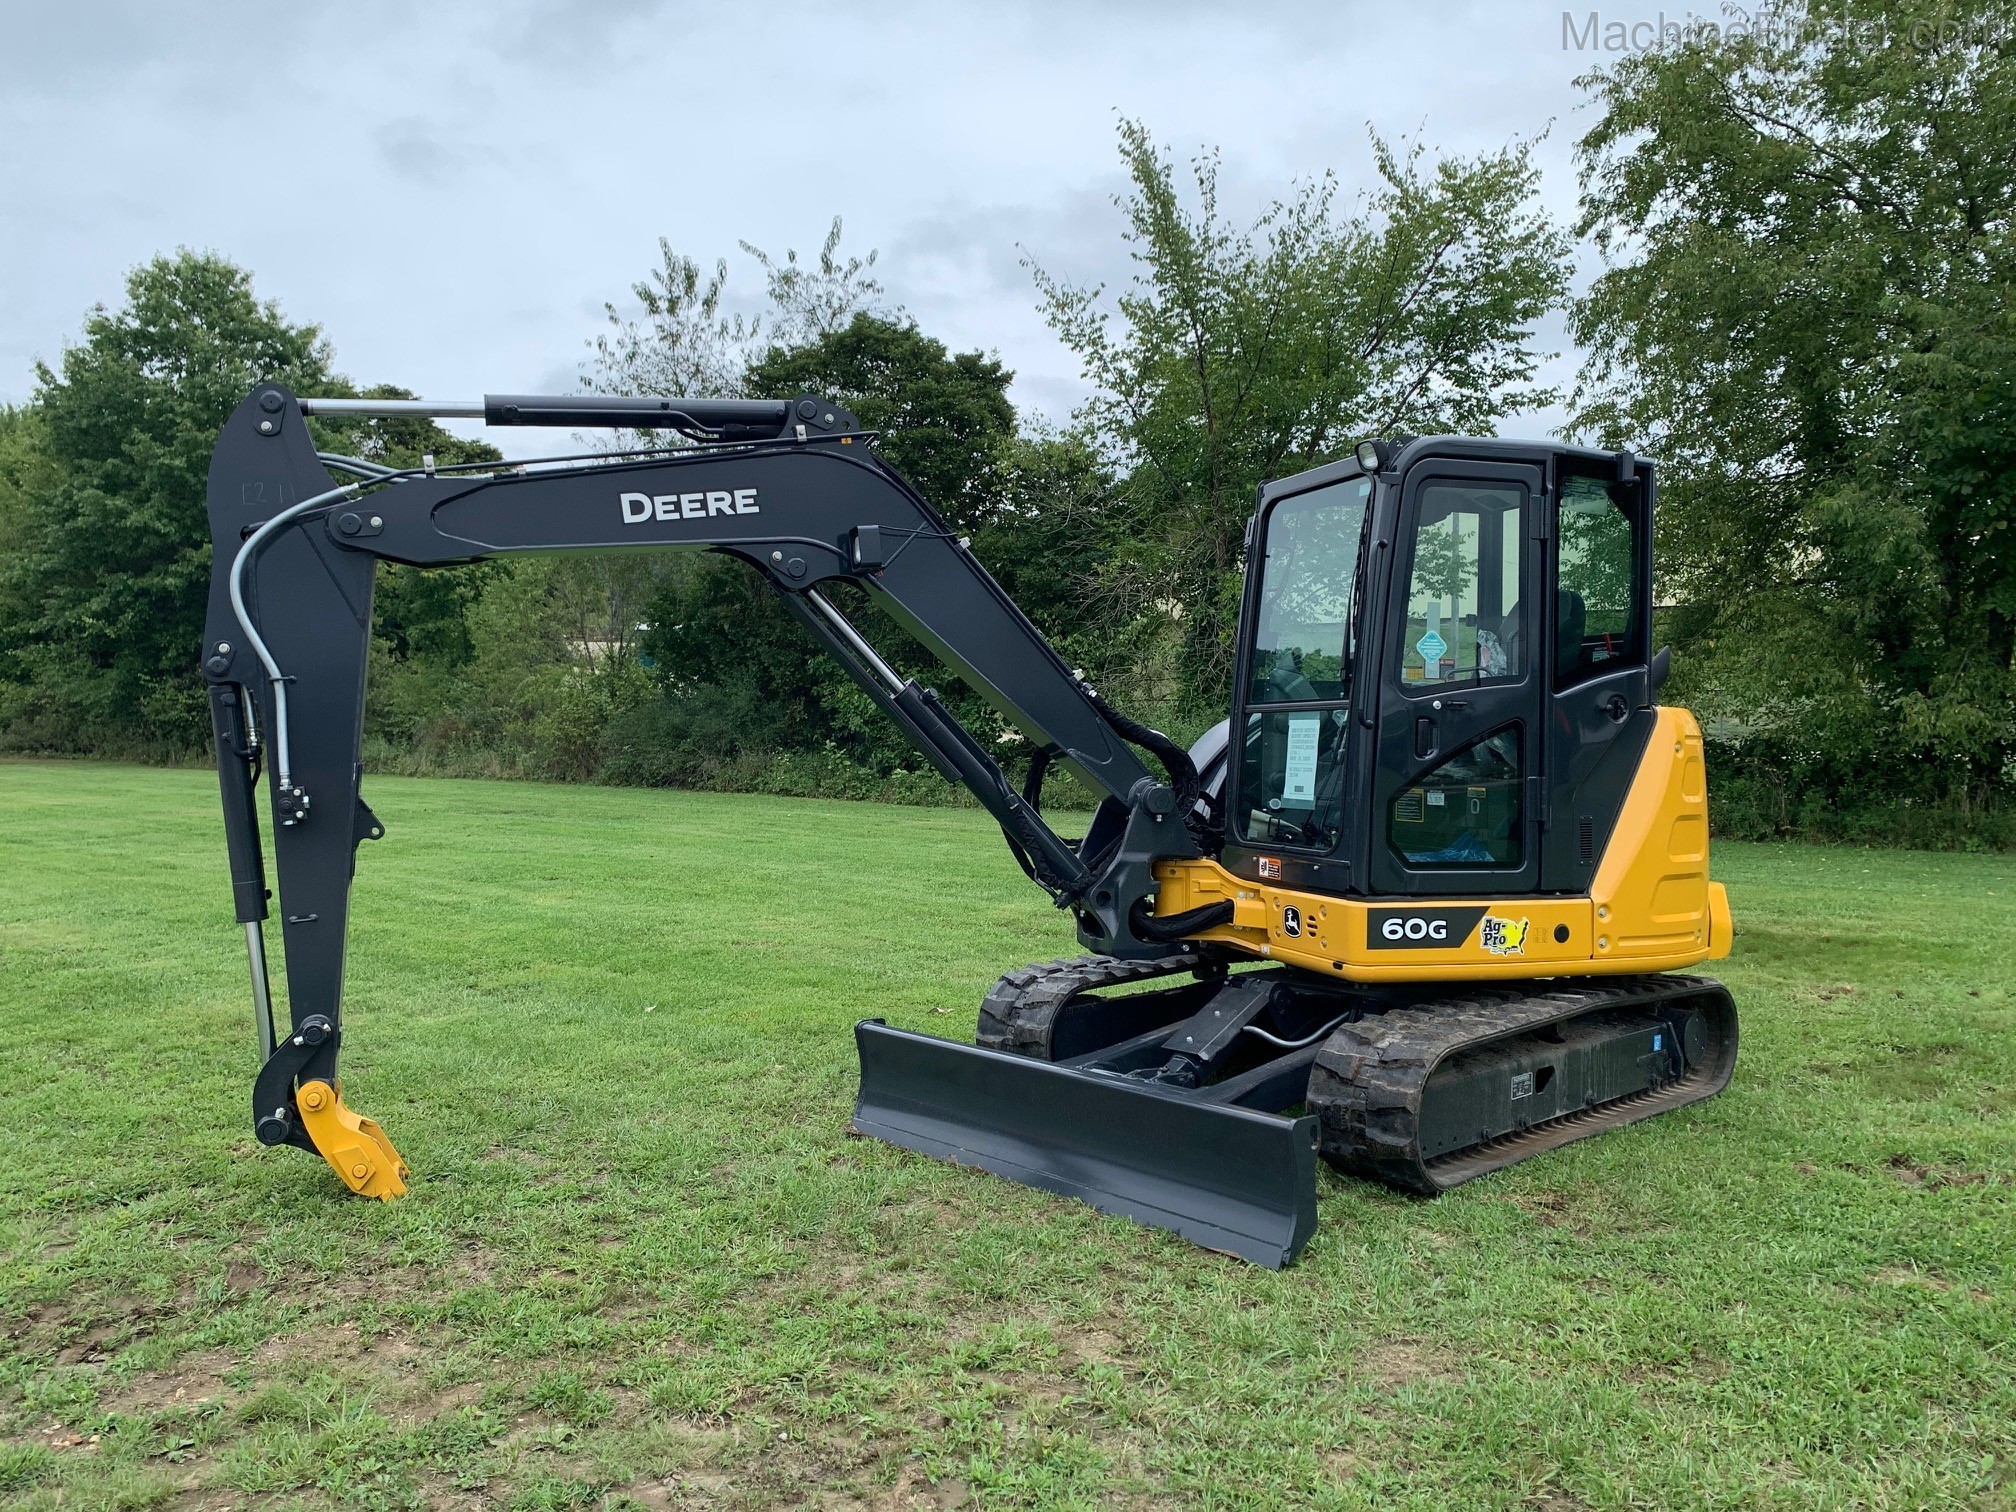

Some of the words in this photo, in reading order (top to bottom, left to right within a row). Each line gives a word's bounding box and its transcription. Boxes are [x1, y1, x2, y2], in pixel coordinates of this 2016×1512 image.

[620, 488, 760, 524] DEERE
[1381, 917, 1447, 940] 60G
[1483, 919, 1507, 935] Ag-
[1483, 932, 1507, 946] Pro
